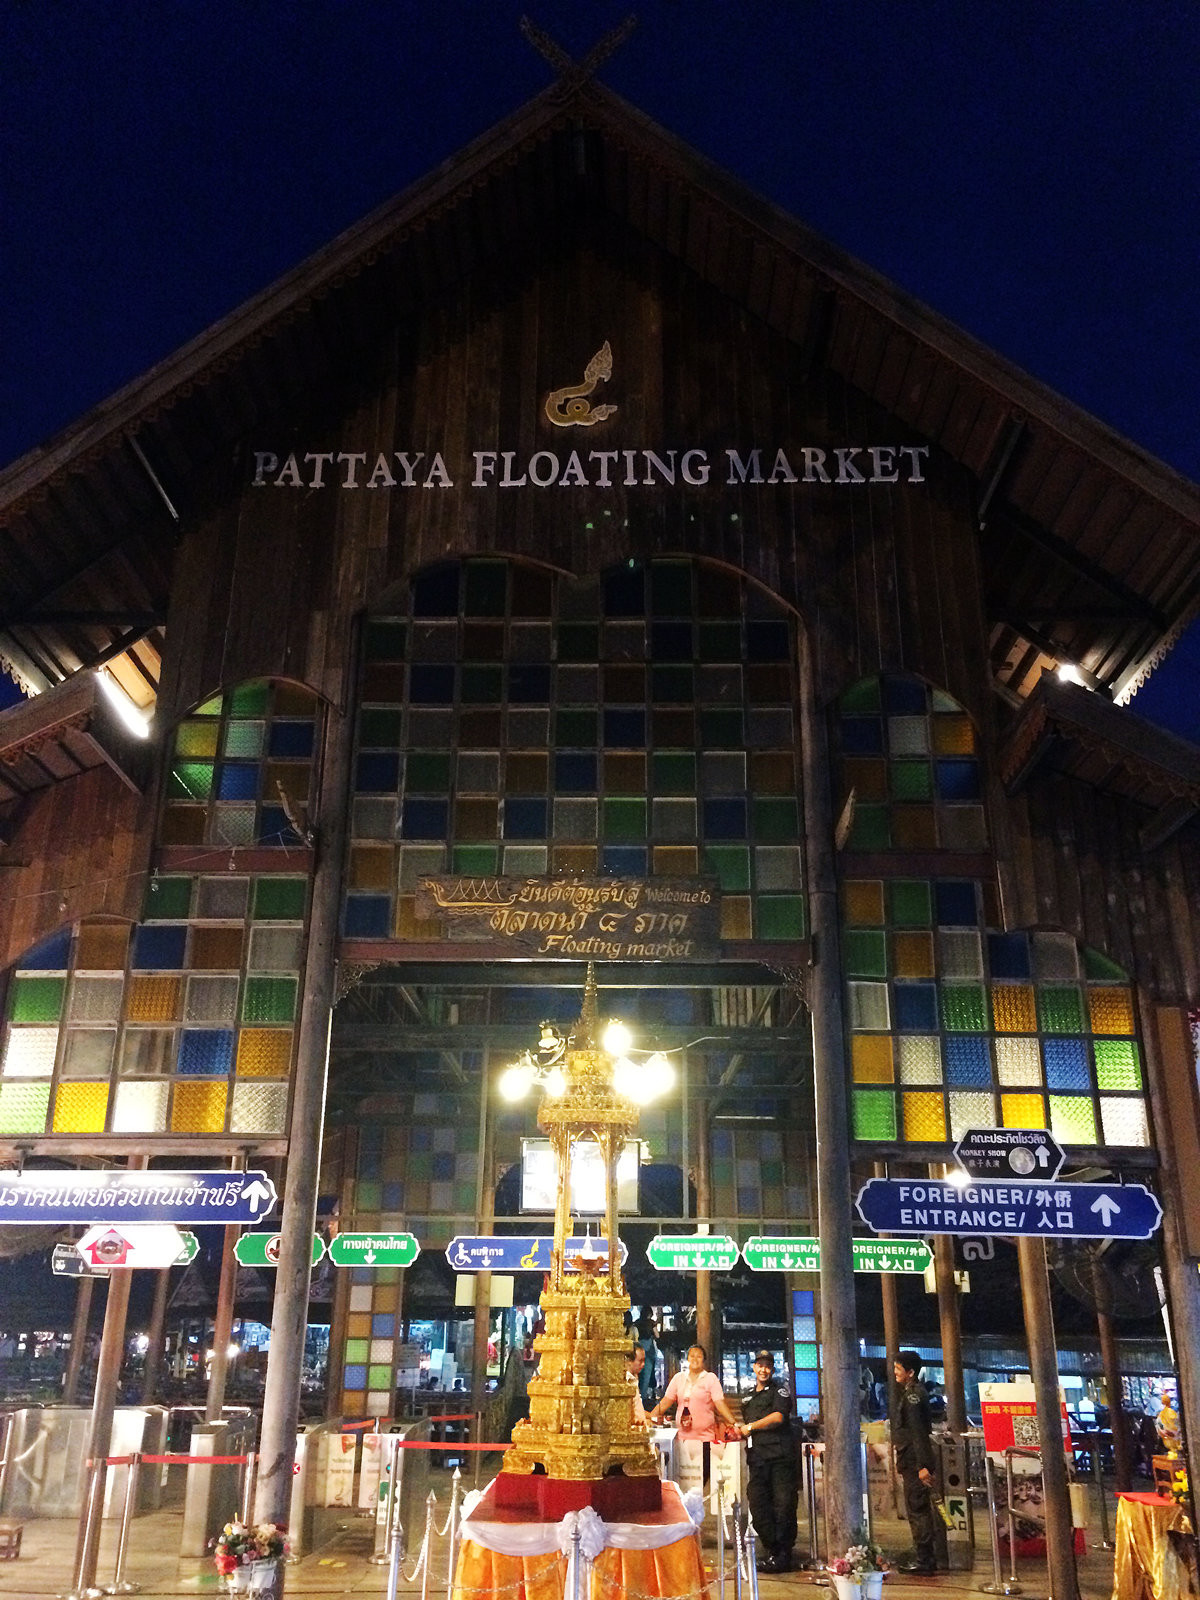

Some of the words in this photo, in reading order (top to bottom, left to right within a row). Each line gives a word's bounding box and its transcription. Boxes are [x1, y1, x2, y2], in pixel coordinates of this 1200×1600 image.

[251, 451, 453, 489] PATTAYA
[471, 449, 711, 488] FLOATING
[725, 446, 930, 484] MARKET
[538, 934, 622, 958] Floating
[627, 938, 695, 958] market
[987, 1149, 1007, 1157] SHOW
[0, 1180, 244, 1207] เราคนไทยด้วยกนเข้าฟรี
[900, 1209, 1027, 1228] ENTRANCE/
[673, 1255, 688, 1267] IN
[762, 1256, 777, 1268] IN
[859, 1258, 874, 1269] IN
